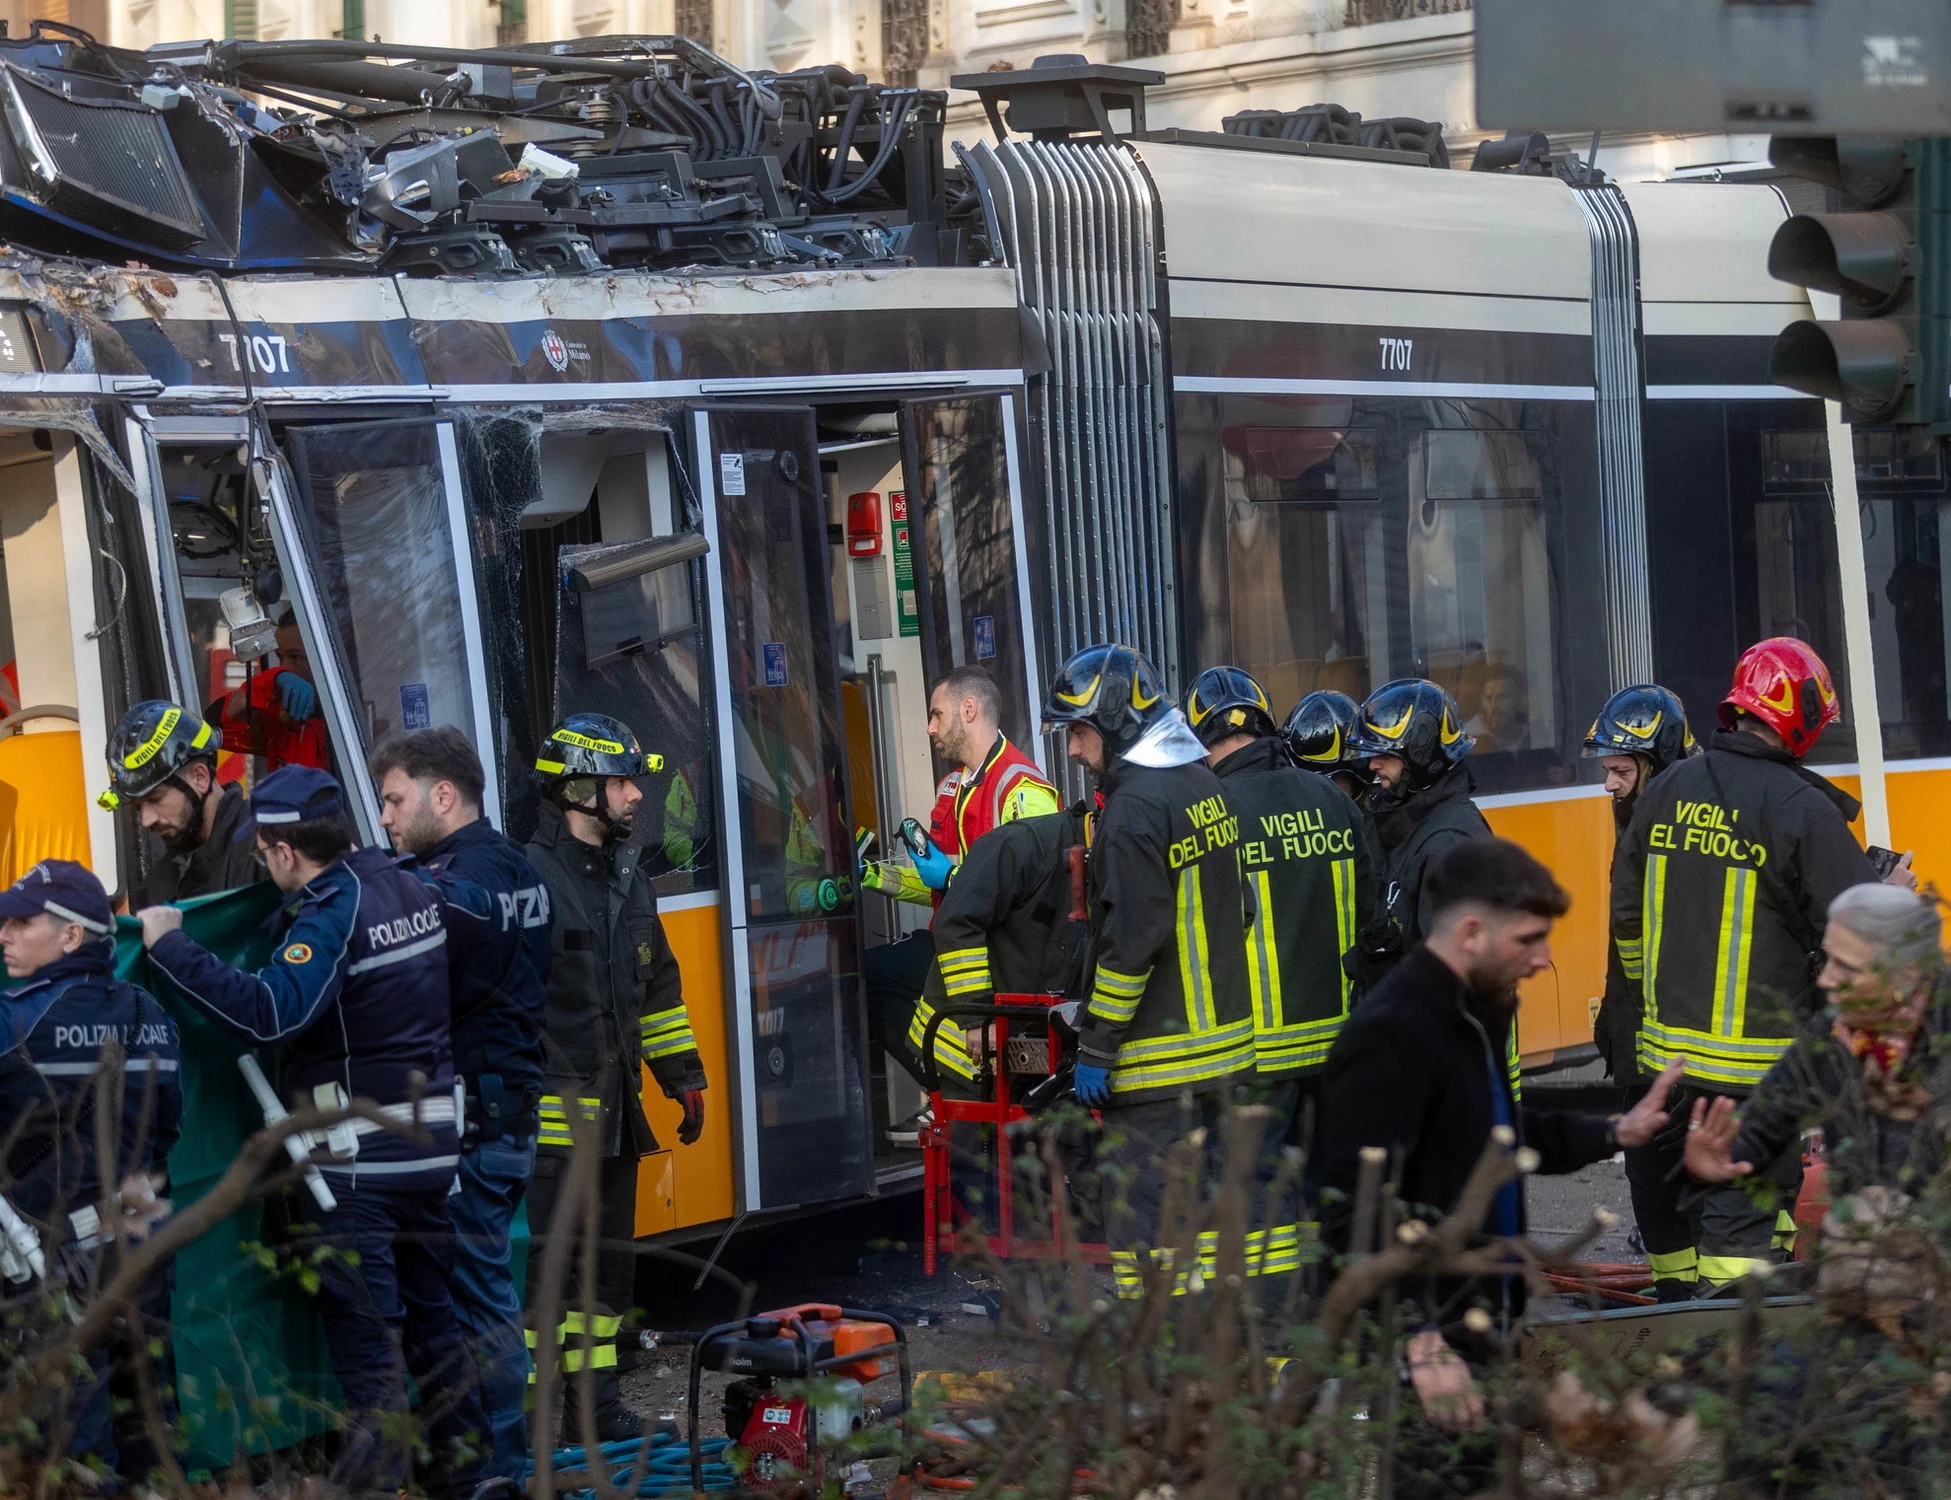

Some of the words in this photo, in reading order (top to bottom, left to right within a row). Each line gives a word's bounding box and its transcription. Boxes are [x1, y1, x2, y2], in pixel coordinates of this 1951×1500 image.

[218, 334, 290, 374] 7707
[1379, 338, 1413, 371] 7707
[134, 744, 156, 764] VIGILI
[153, 731, 167, 746] DEL
[558, 732, 577, 743] VIGILI
[578, 737, 591, 747] DEL
[593, 741, 617, 753] FUOCO
[1185, 794, 1228, 829] VIGILI
[1260, 808, 1325, 837] VIGILI
[1169, 835, 1205, 869] DEL
[1242, 841, 1275, 865] EL
